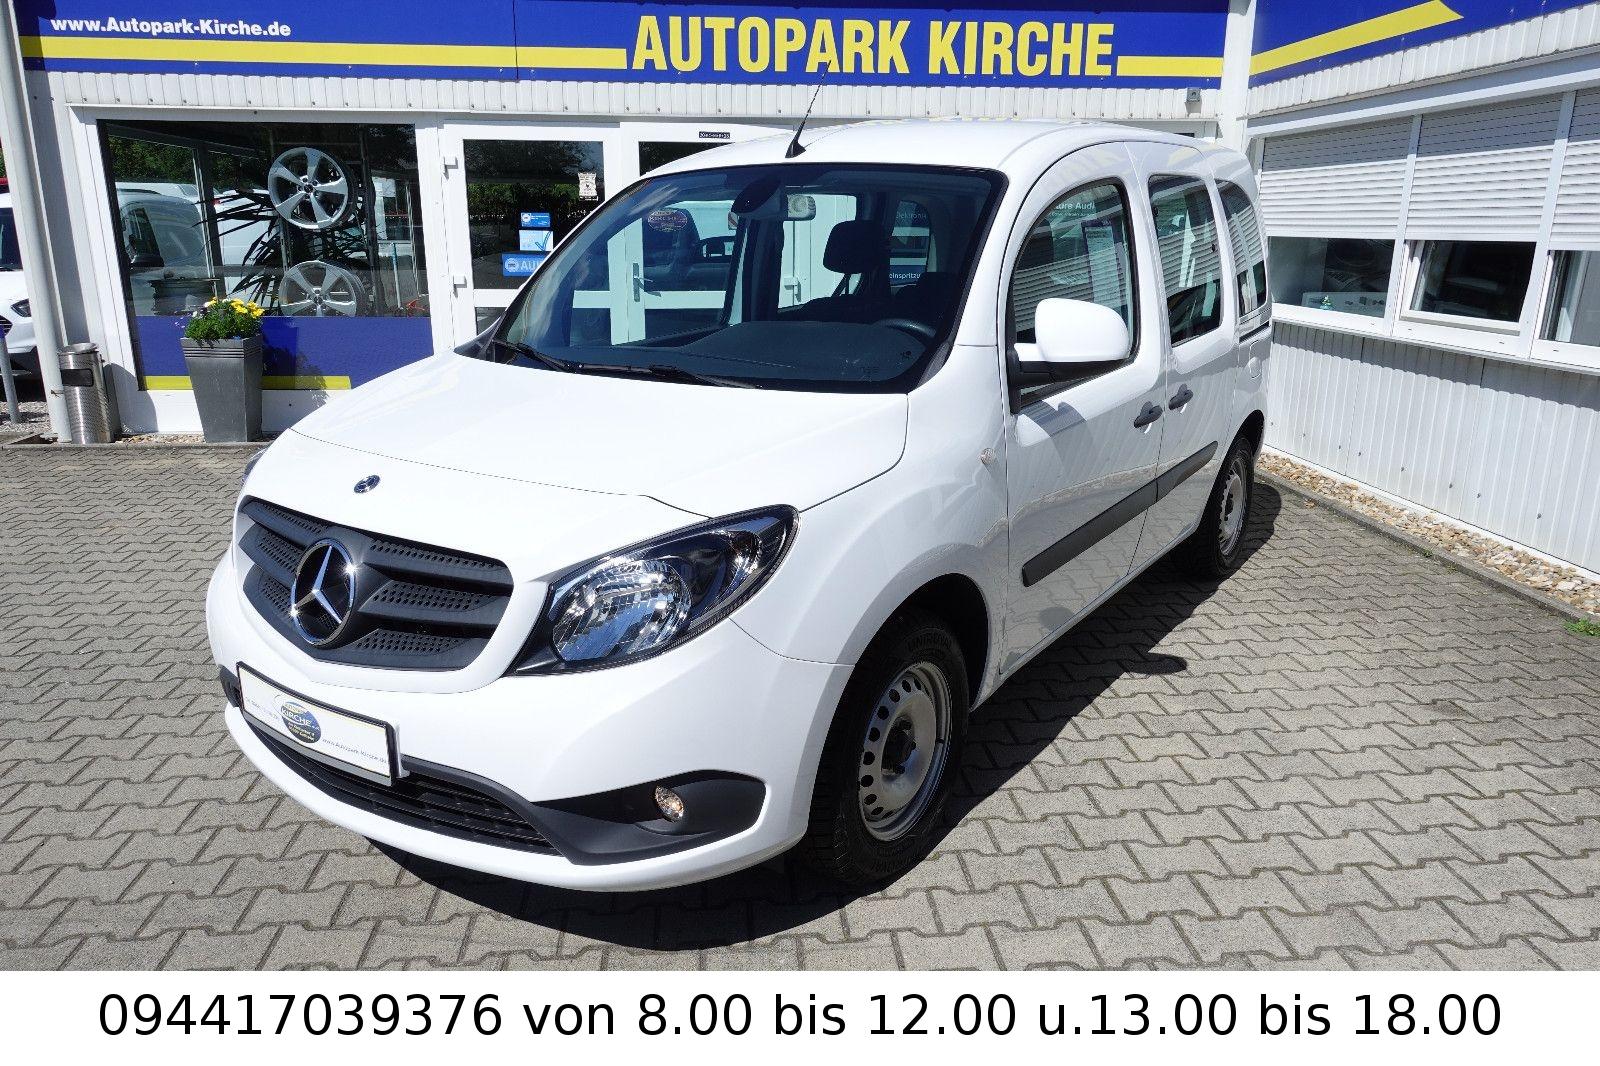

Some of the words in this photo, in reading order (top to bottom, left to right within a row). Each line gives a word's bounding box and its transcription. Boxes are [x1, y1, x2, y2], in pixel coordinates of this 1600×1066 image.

[50, 17, 291, 36] www.Autopark-Kirche.de
[632, 15, 909, 75] AUTOPARK
[929, 20, 1115, 77] KIRCHE
